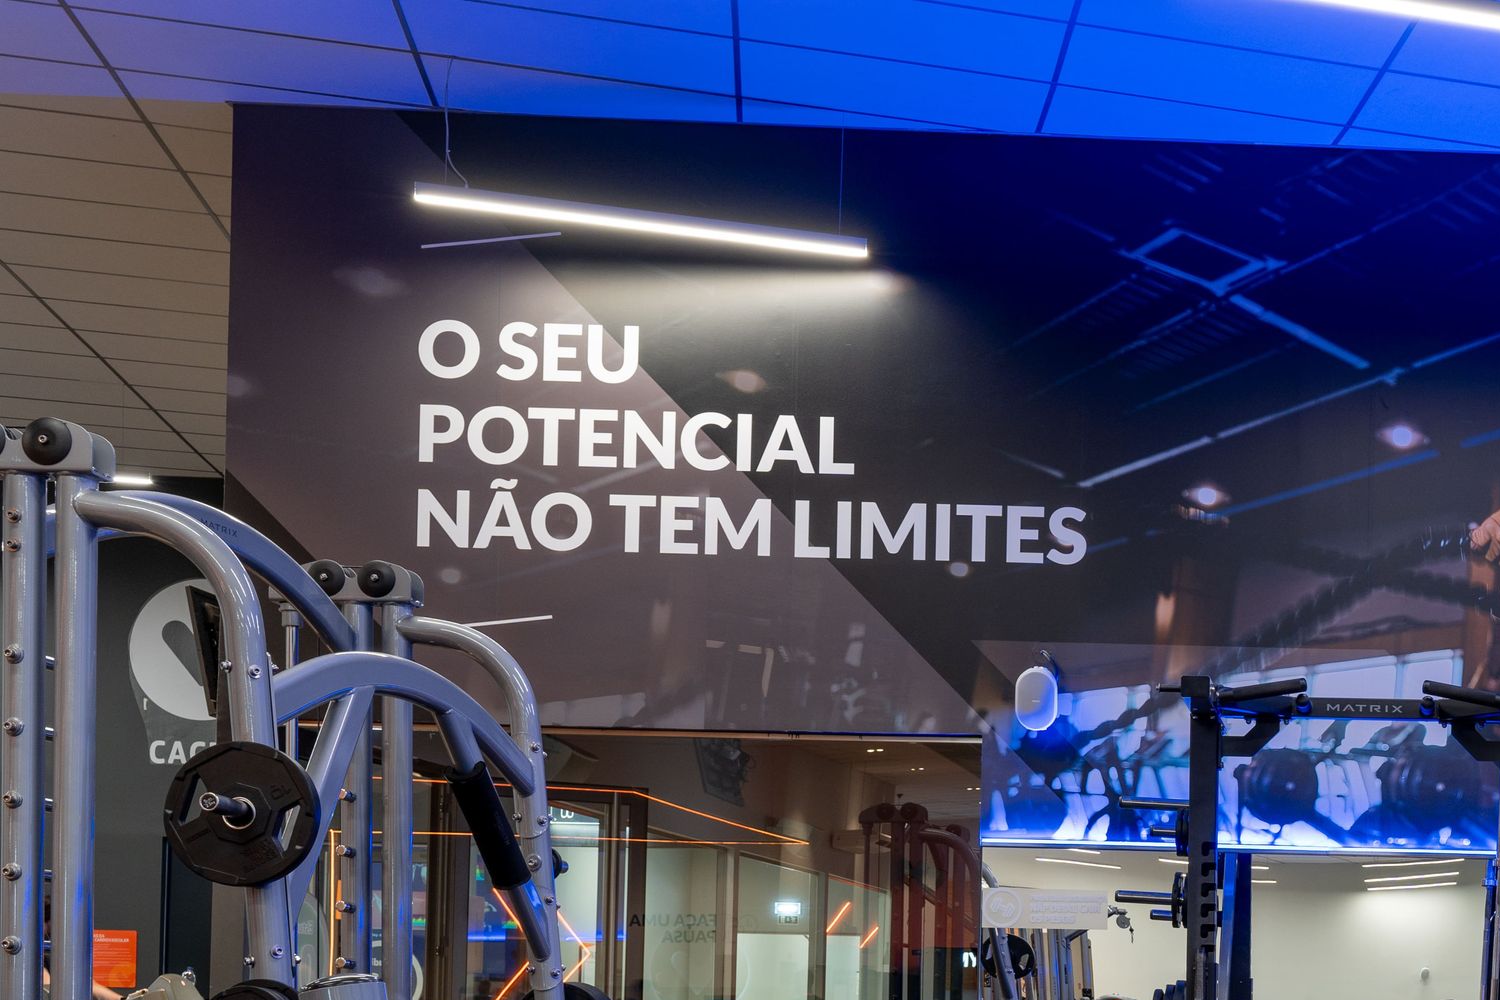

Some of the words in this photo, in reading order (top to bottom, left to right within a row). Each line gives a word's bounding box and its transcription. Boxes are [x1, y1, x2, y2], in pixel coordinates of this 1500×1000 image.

[418, 319, 481, 380] O
[496, 321, 640, 384] SEU
[418, 403, 855, 476] POTENCIAL
[201, 517, 238, 538] MATRIX
[416, 478, 593, 552] NÃO
[609, 494, 771, 557] TEM
[795, 501, 1089, 565] LIMITES
[1326, 703, 1403, 714] MATRIX
[149, 740, 217, 765] CAC
